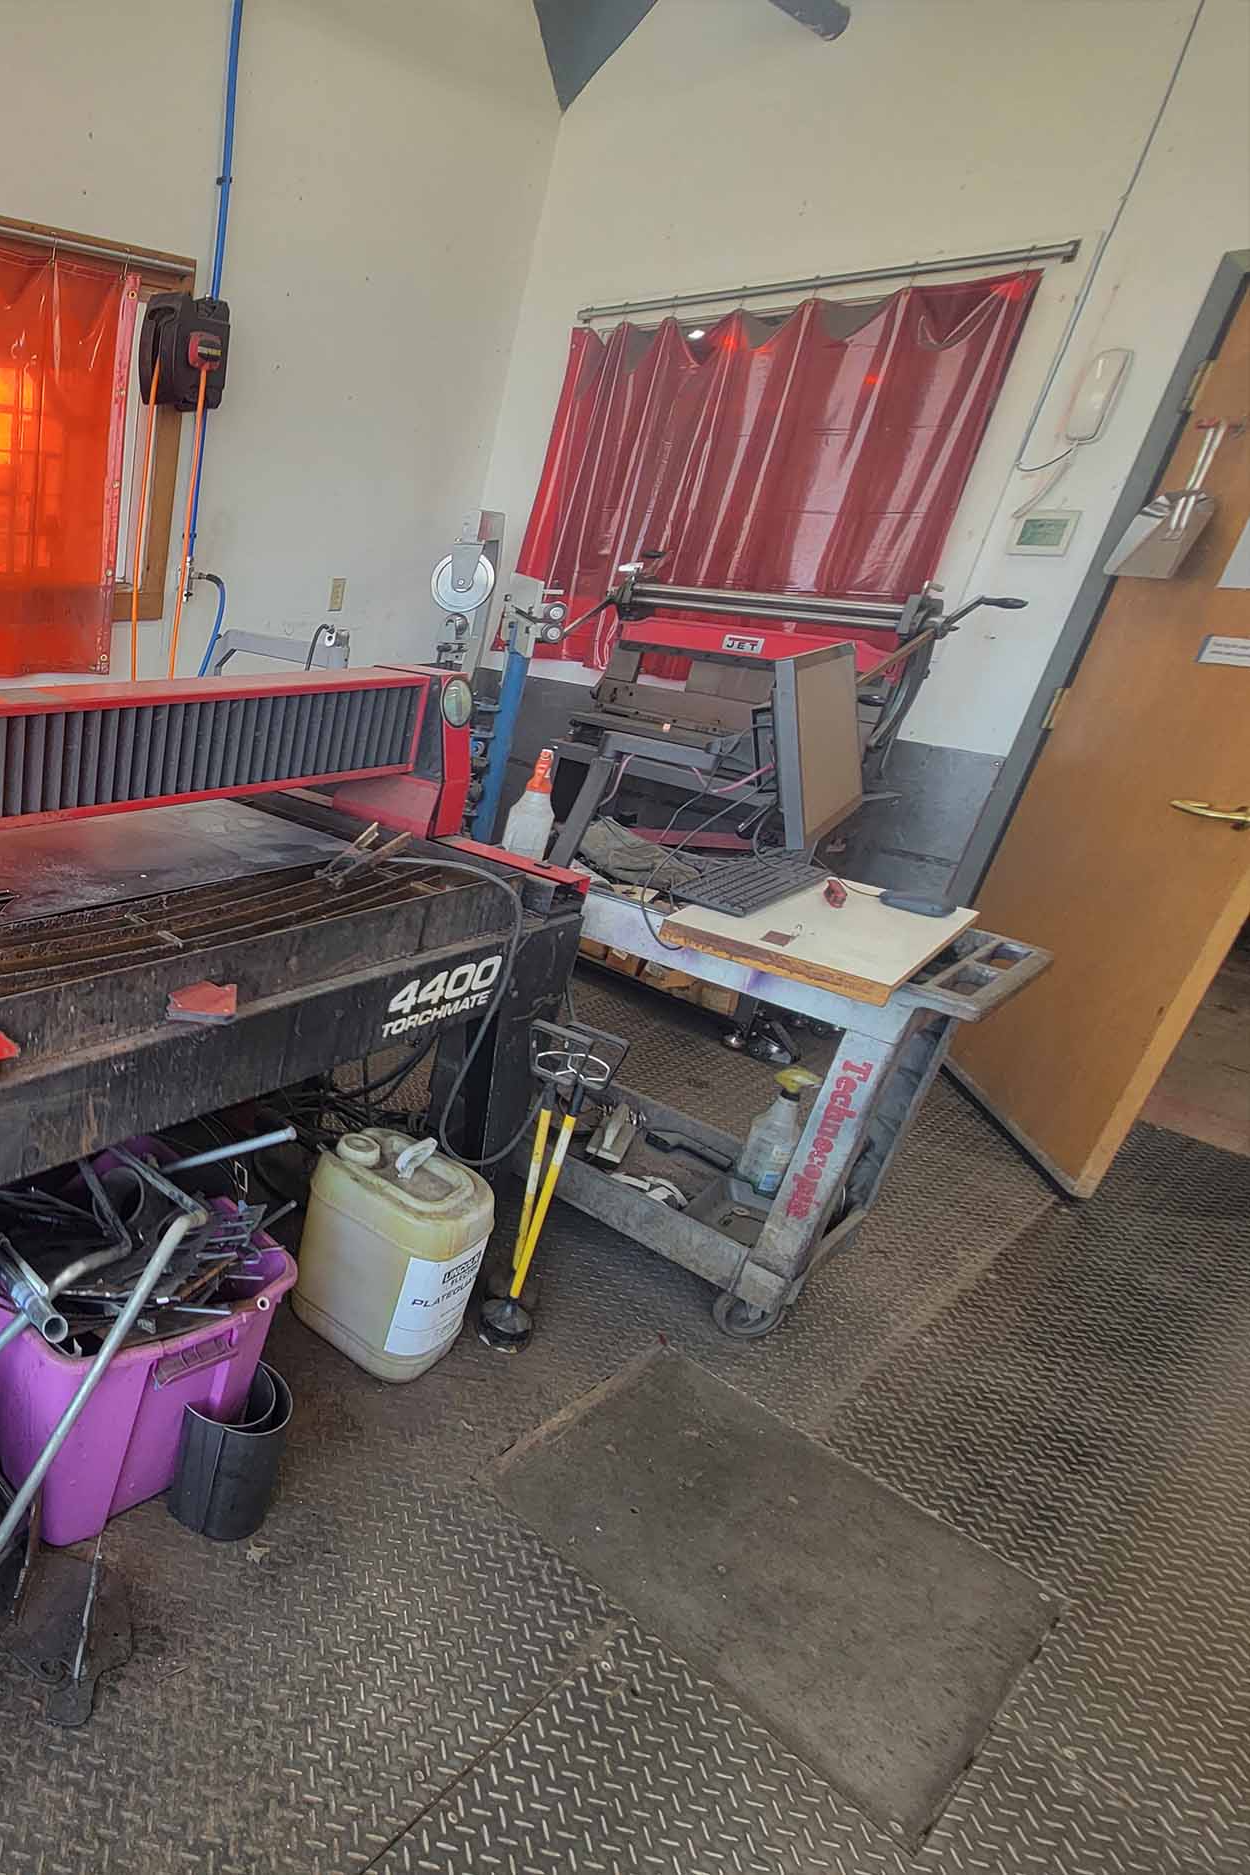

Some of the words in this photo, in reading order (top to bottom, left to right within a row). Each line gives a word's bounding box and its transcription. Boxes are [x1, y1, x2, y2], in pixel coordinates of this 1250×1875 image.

[726, 637, 759, 651] JET
[388, 955, 502, 1014] 4400
[381, 990, 491, 1039] TORCHMATE
